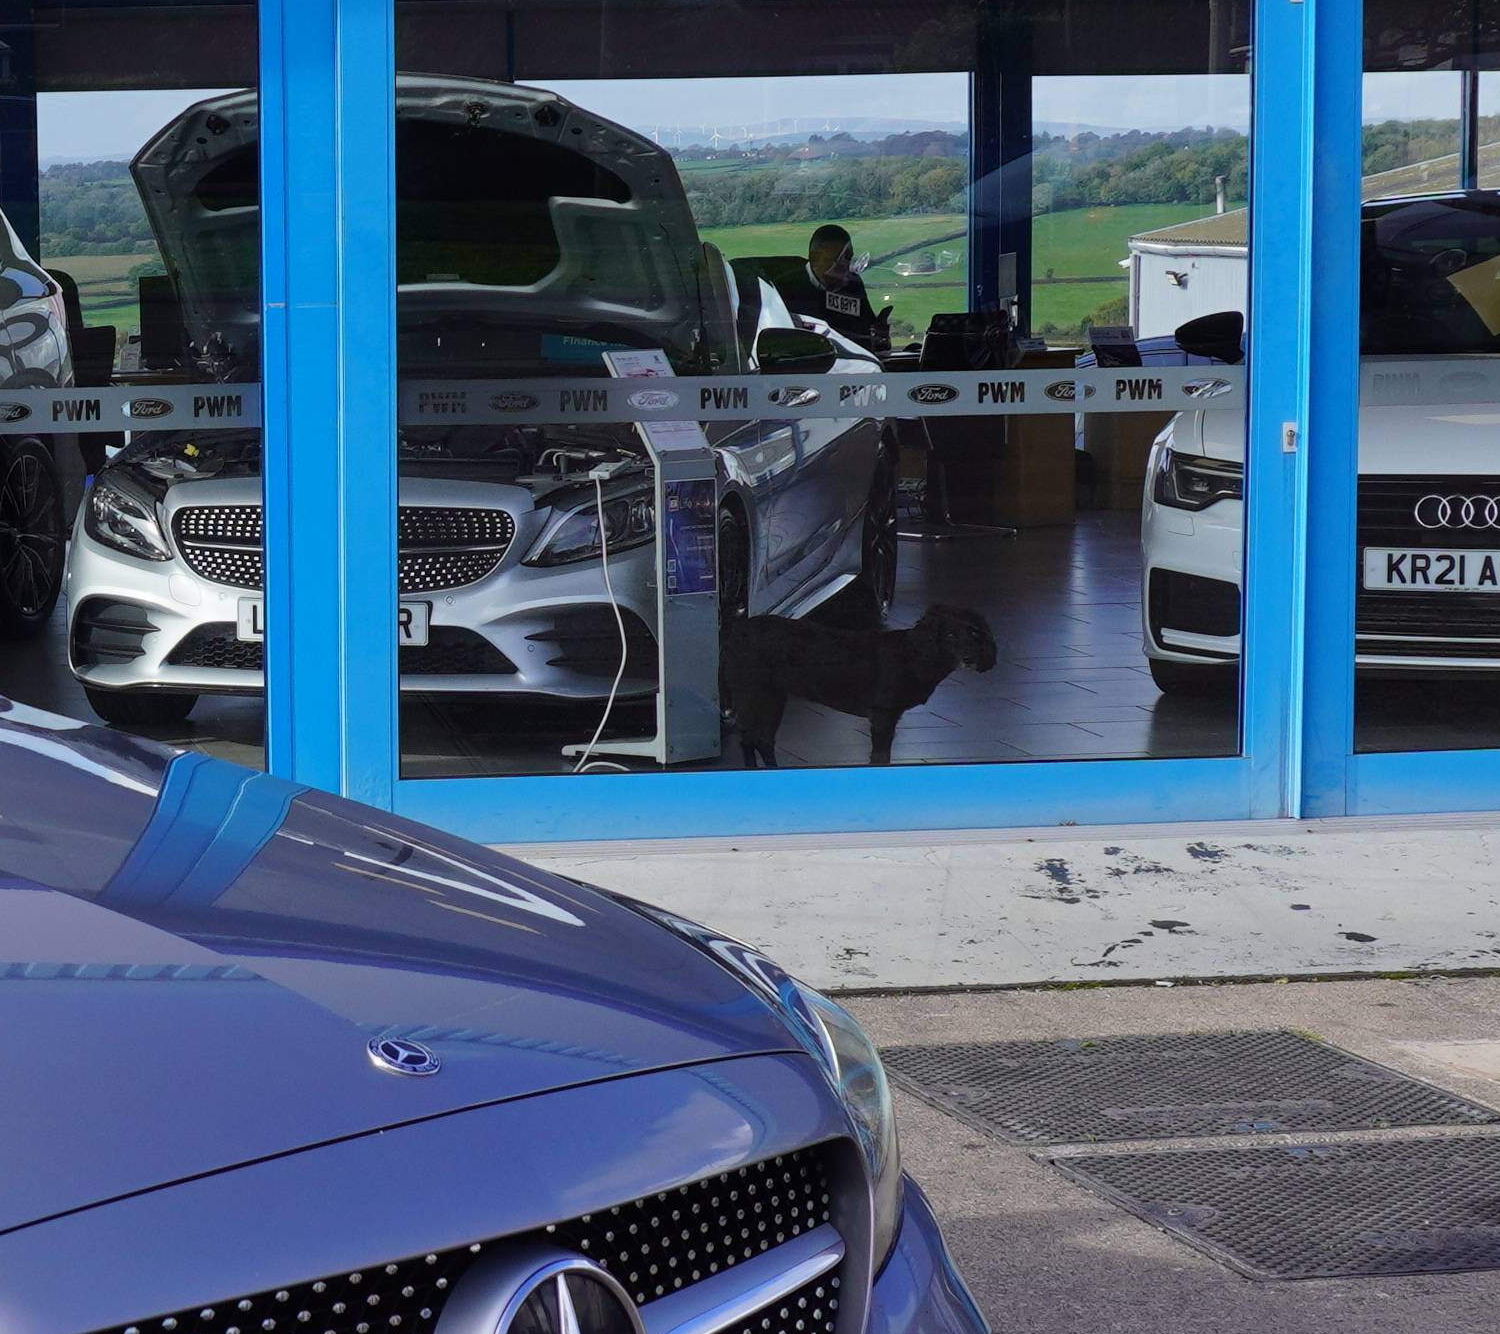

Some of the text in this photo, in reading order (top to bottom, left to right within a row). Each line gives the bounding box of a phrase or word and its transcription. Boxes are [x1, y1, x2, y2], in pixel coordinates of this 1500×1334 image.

[52, 399, 100, 422] PWM
[194, 395, 242, 418] PWM
[560, 389, 608, 412] PWM
[700, 387, 748, 409] PWM
[978, 382, 1025, 404] PWM
[1115, 379, 1162, 400] PWM
[1387, 553, 1465, 585] KR21
